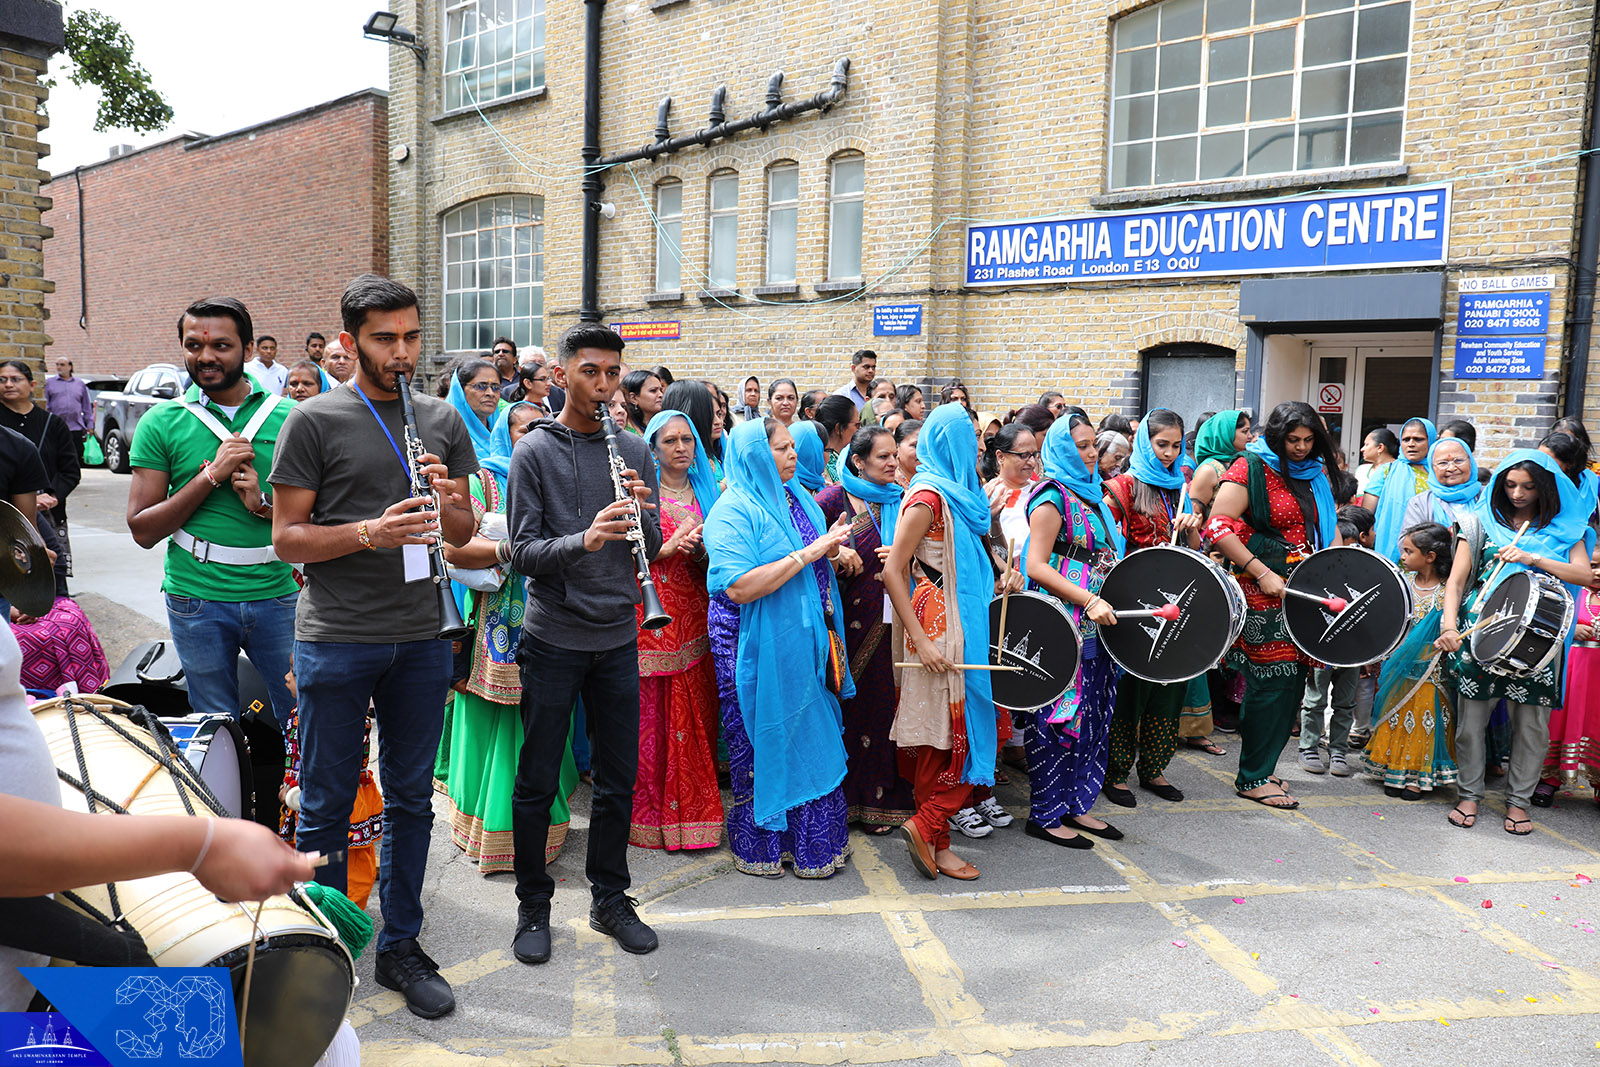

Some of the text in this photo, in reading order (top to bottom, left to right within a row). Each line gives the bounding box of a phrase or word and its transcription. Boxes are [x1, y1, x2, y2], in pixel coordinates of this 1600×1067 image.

[971, 194, 1439, 266] RAMGARHIA EDUCATION CENTRE
[974, 268, 994, 280] 231
[997, 266, 1040, 279] Plashet
[1043, 264, 1074, 277] Road
[1082, 261, 1130, 275] London
[1463, 276, 1548, 290] NO BALL GAMES
[1474, 299, 1534, 309] RAMGARHIA
[1465, 309, 1542, 318] PANJABI SCHOOL
[1464, 318, 1540, 328] 020 8471 9506
[1484, 341, 1513, 350] Community
[1488, 357, 1510, 366] Learning
[1466, 365, 1531, 374] 020 8472 9134
[1184, 588, 1198, 607] TEMPLE
